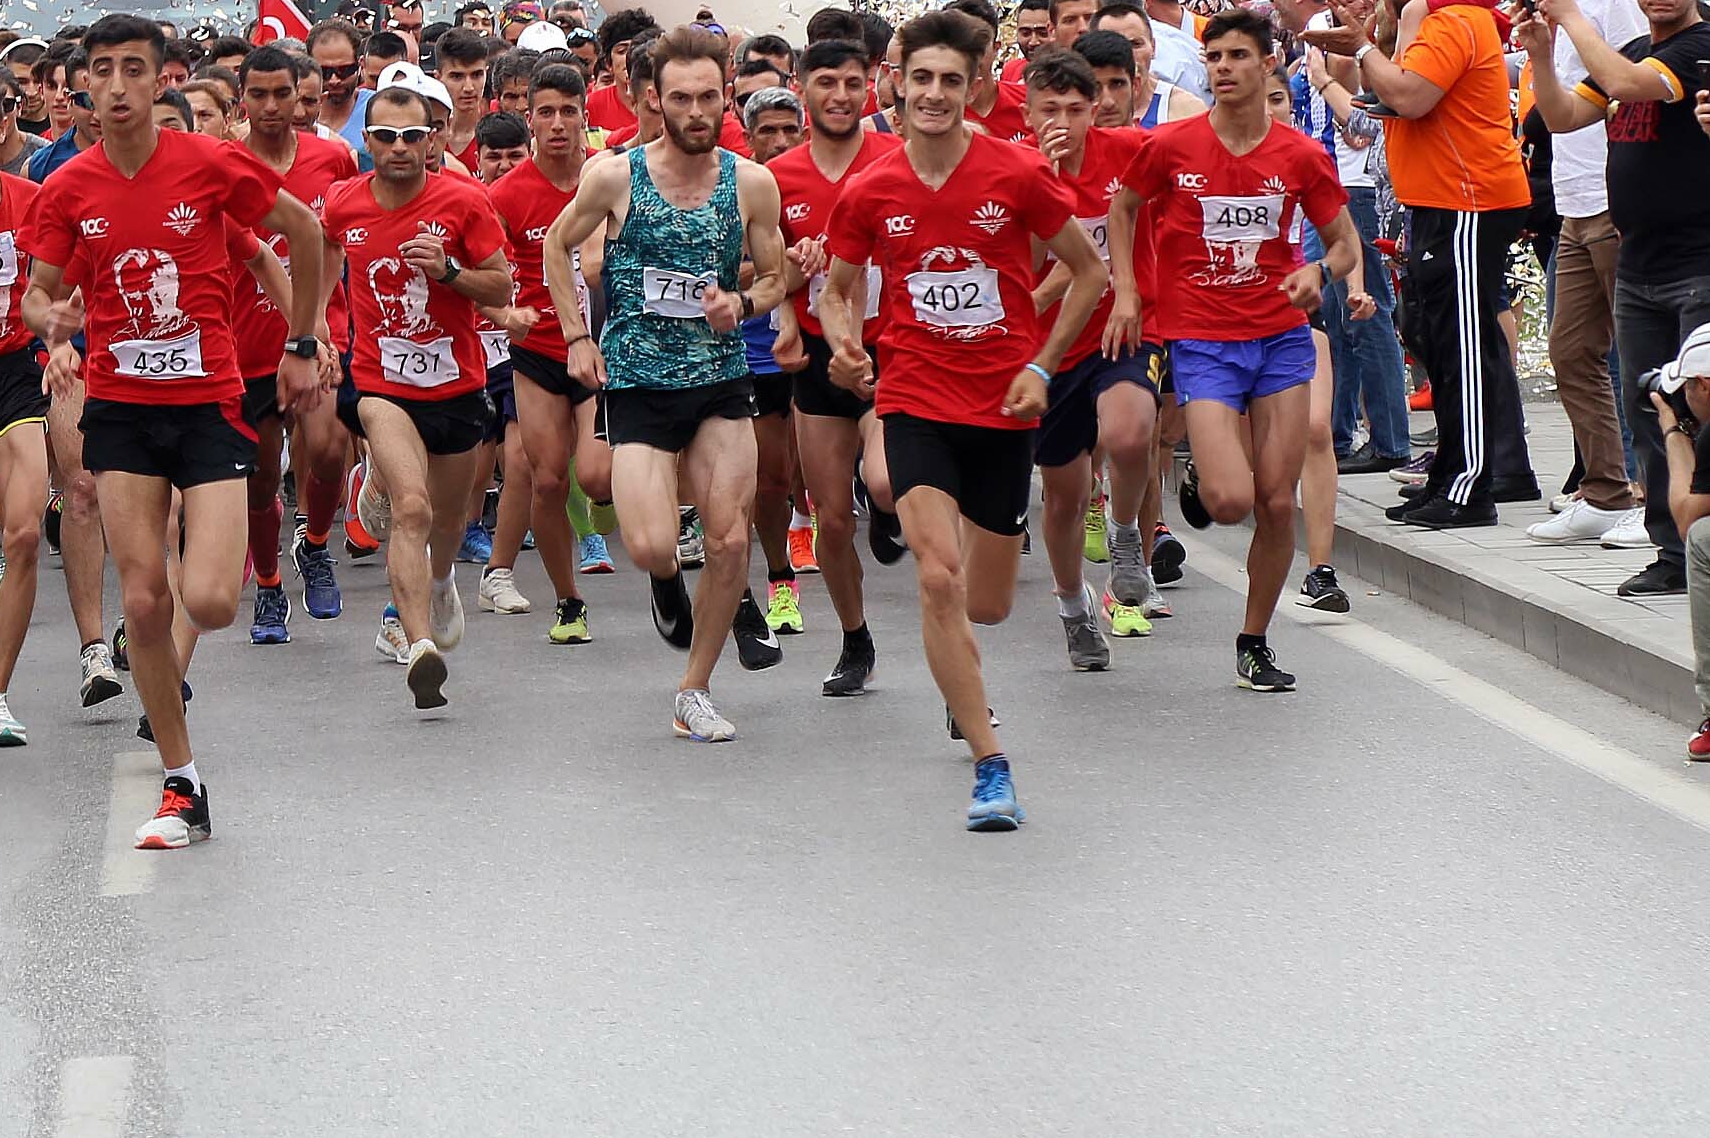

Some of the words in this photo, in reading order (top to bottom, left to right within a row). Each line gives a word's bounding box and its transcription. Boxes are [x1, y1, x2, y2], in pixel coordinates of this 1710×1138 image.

[1216, 205, 1269, 229] 408
[656, 277, 708, 301] 718
[923, 282, 983, 312] 402
[133, 348, 188, 374] 435
[393, 352, 441, 375] 731
